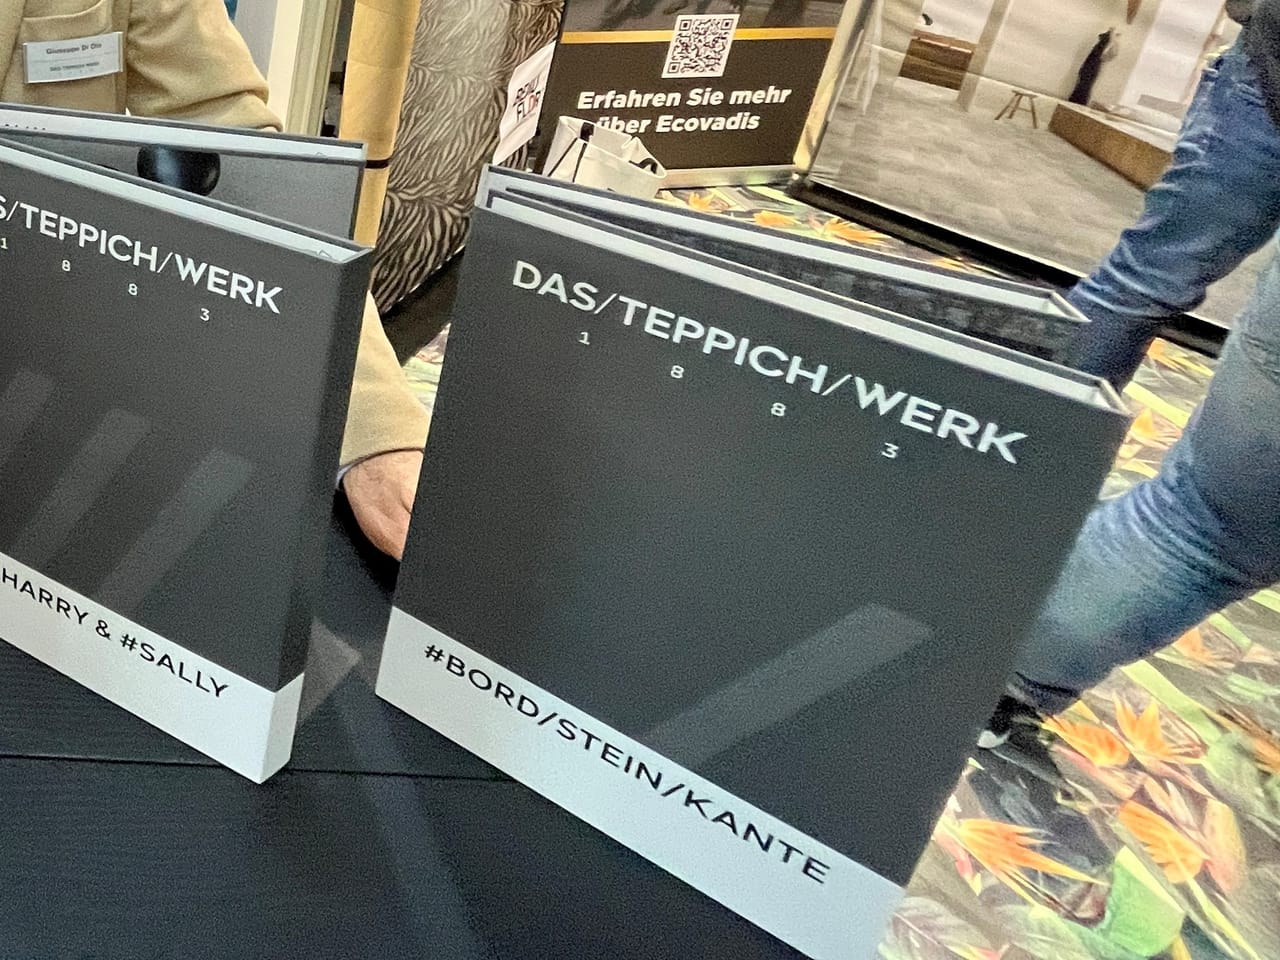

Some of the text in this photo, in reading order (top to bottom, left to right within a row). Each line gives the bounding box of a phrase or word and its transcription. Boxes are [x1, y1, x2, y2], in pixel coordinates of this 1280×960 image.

[577, 86, 792, 110] Erfahren Sie mehr
[655, 112, 761, 133] Ecovadis
[0, 237, 210, 322] 1 8 8 3
[511, 259, 1029, 465] DAS/TEPPICH/WERK
[578, 330, 899, 460] 1 8 8 3
[95, 618, 112, 641] &
[119, 632, 230, 698] #SALLY
[423, 643, 832, 885] #BORD/STEIN/KANTE
